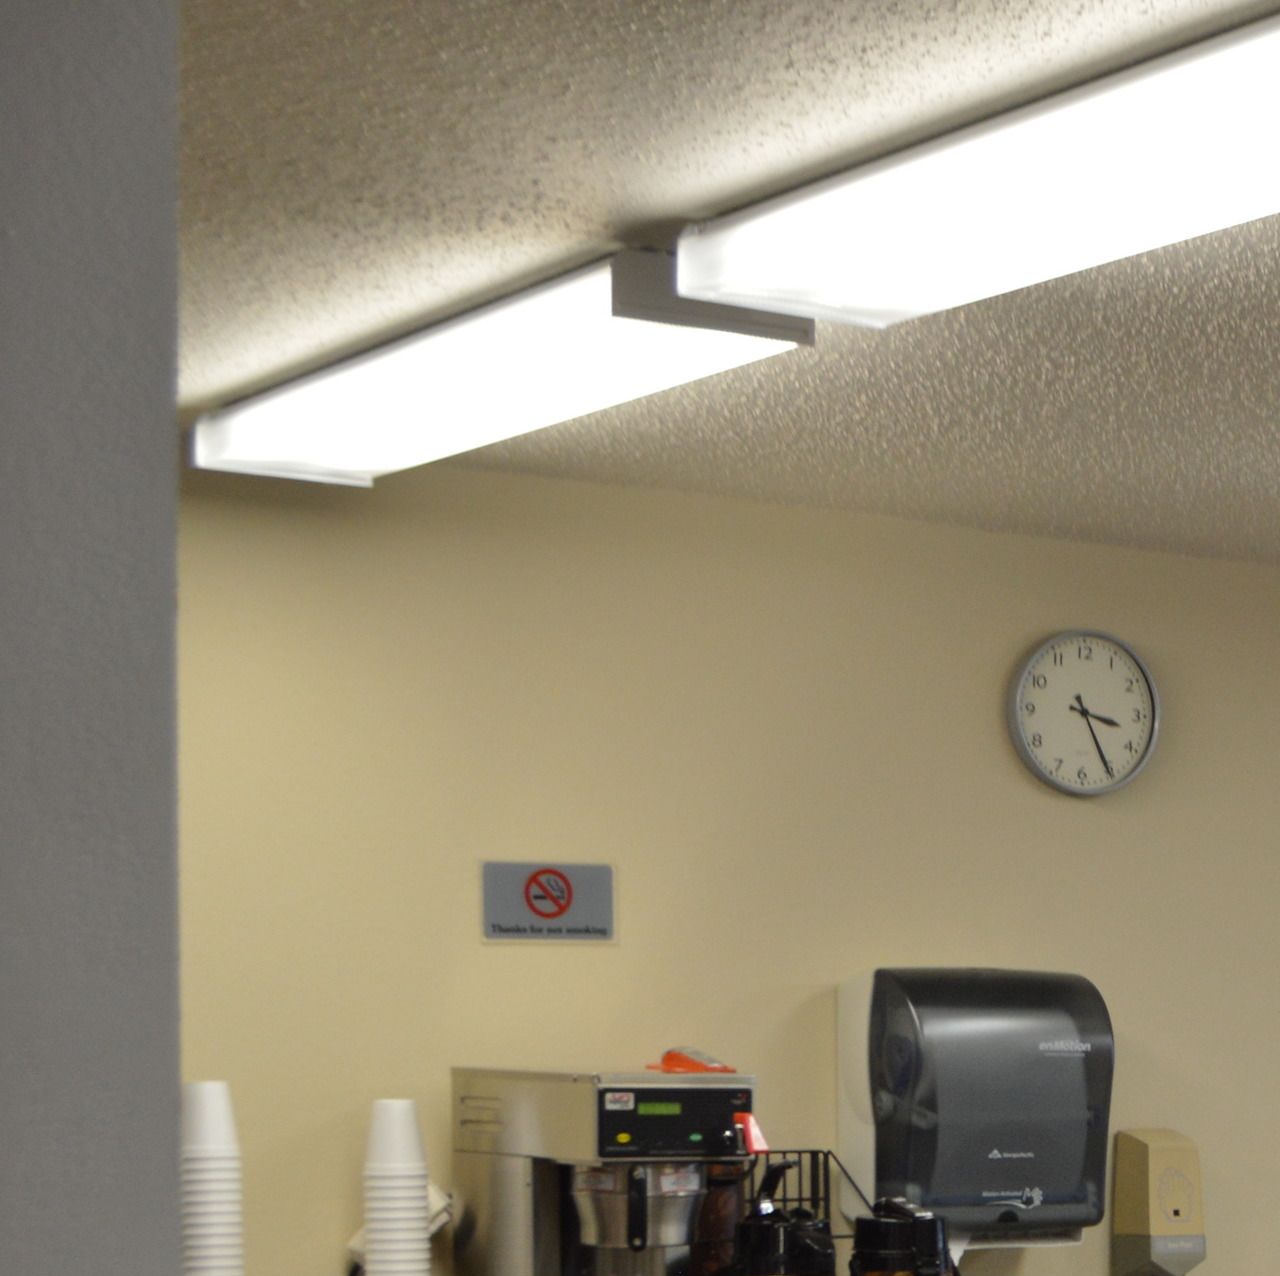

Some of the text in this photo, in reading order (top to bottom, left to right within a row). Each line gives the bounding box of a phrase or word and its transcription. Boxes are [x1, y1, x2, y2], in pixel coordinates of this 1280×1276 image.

[1053, 652, 1063, 667] 11
[1077, 646, 1092, 661] 12
[1032, 674, 1047, 689] 10
[1125, 677, 1134, 693] 2
[1025, 703, 1035, 716] 9
[1132, 707, 1141, 722] 3
[1031, 734, 1042, 748] 8
[1124, 739, 1133, 753] 4
[1054, 758, 1063, 773] 7
[1077, 766, 1088, 780] 6
[491, 923, 527, 933] Thanks
[565, 926, 608, 936] smoking
[1039, 1041, 1091, 1052] enMotion
